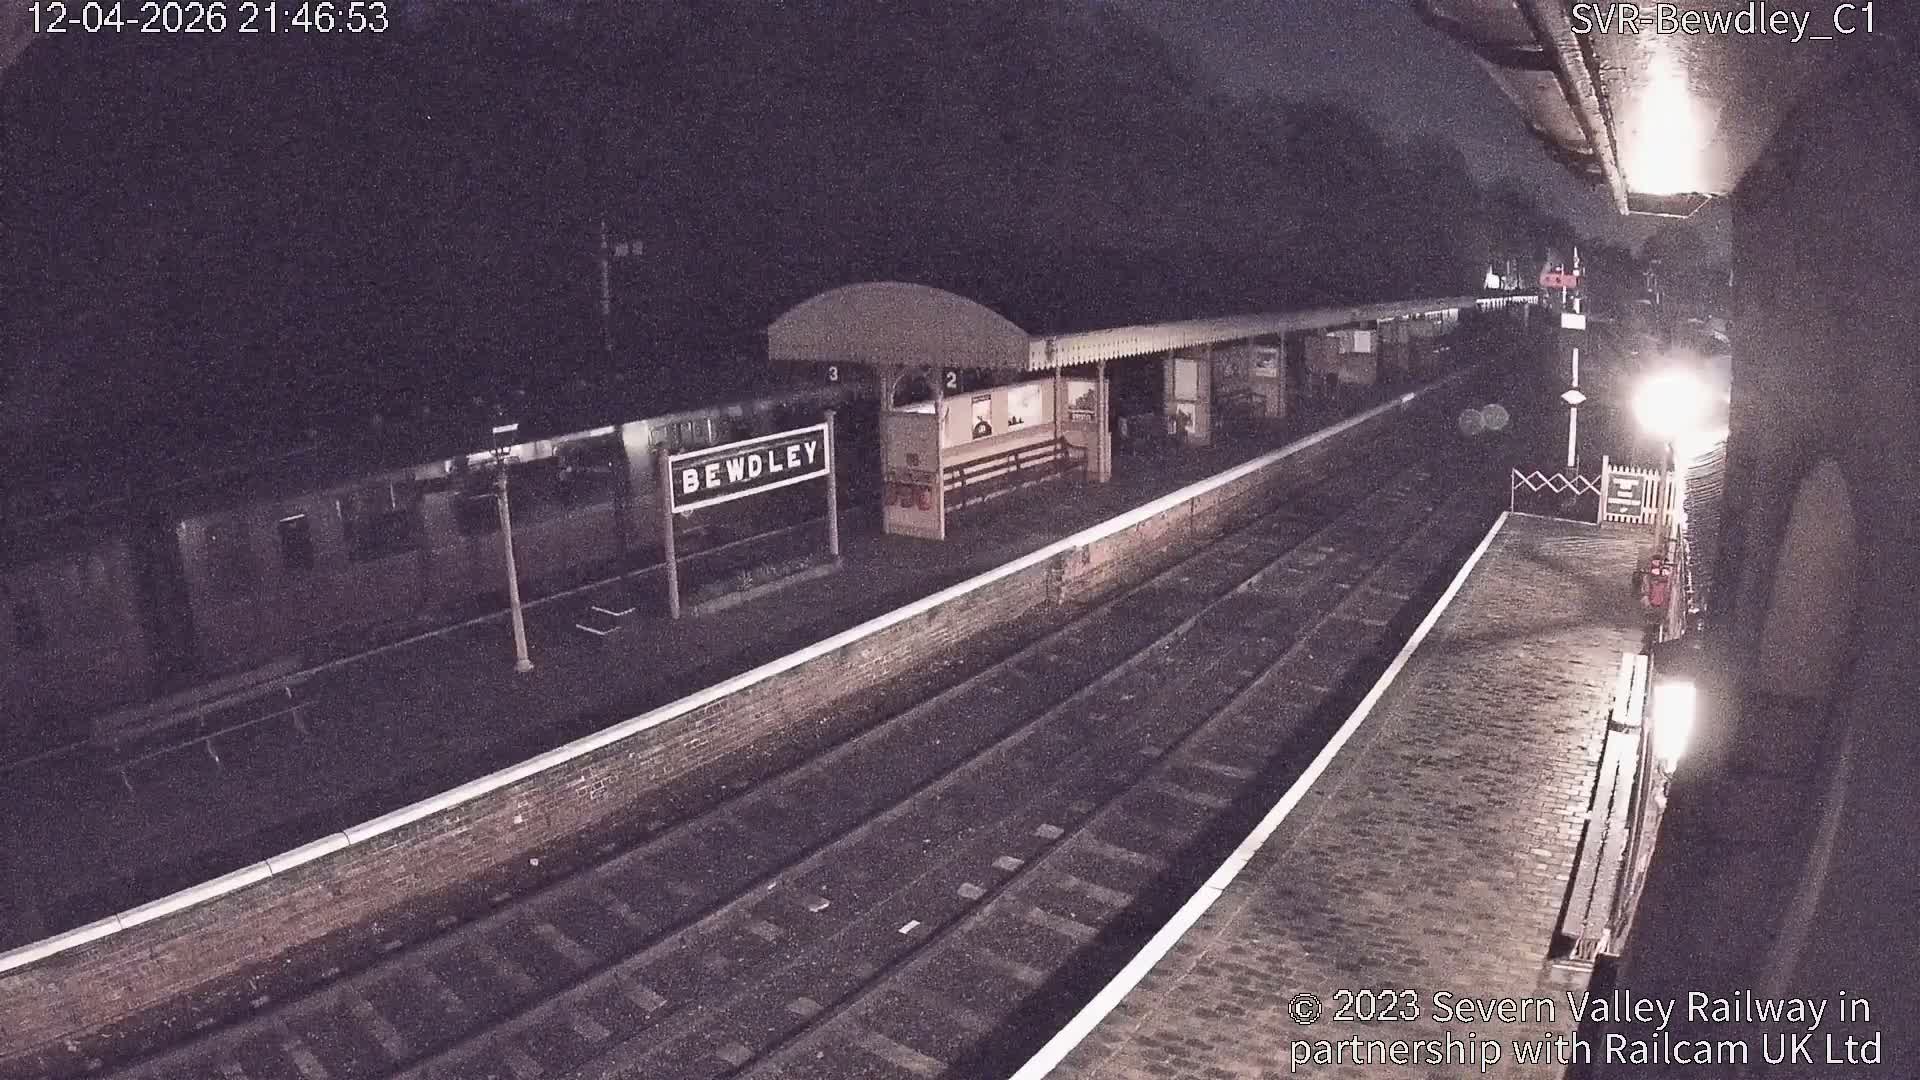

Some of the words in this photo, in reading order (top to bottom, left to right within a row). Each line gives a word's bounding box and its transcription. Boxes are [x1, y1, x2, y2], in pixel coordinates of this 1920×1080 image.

[828, 365, 839, 381] 3
[946, 371, 957, 389] 2
[682, 440, 817, 495] BEWDLEY
